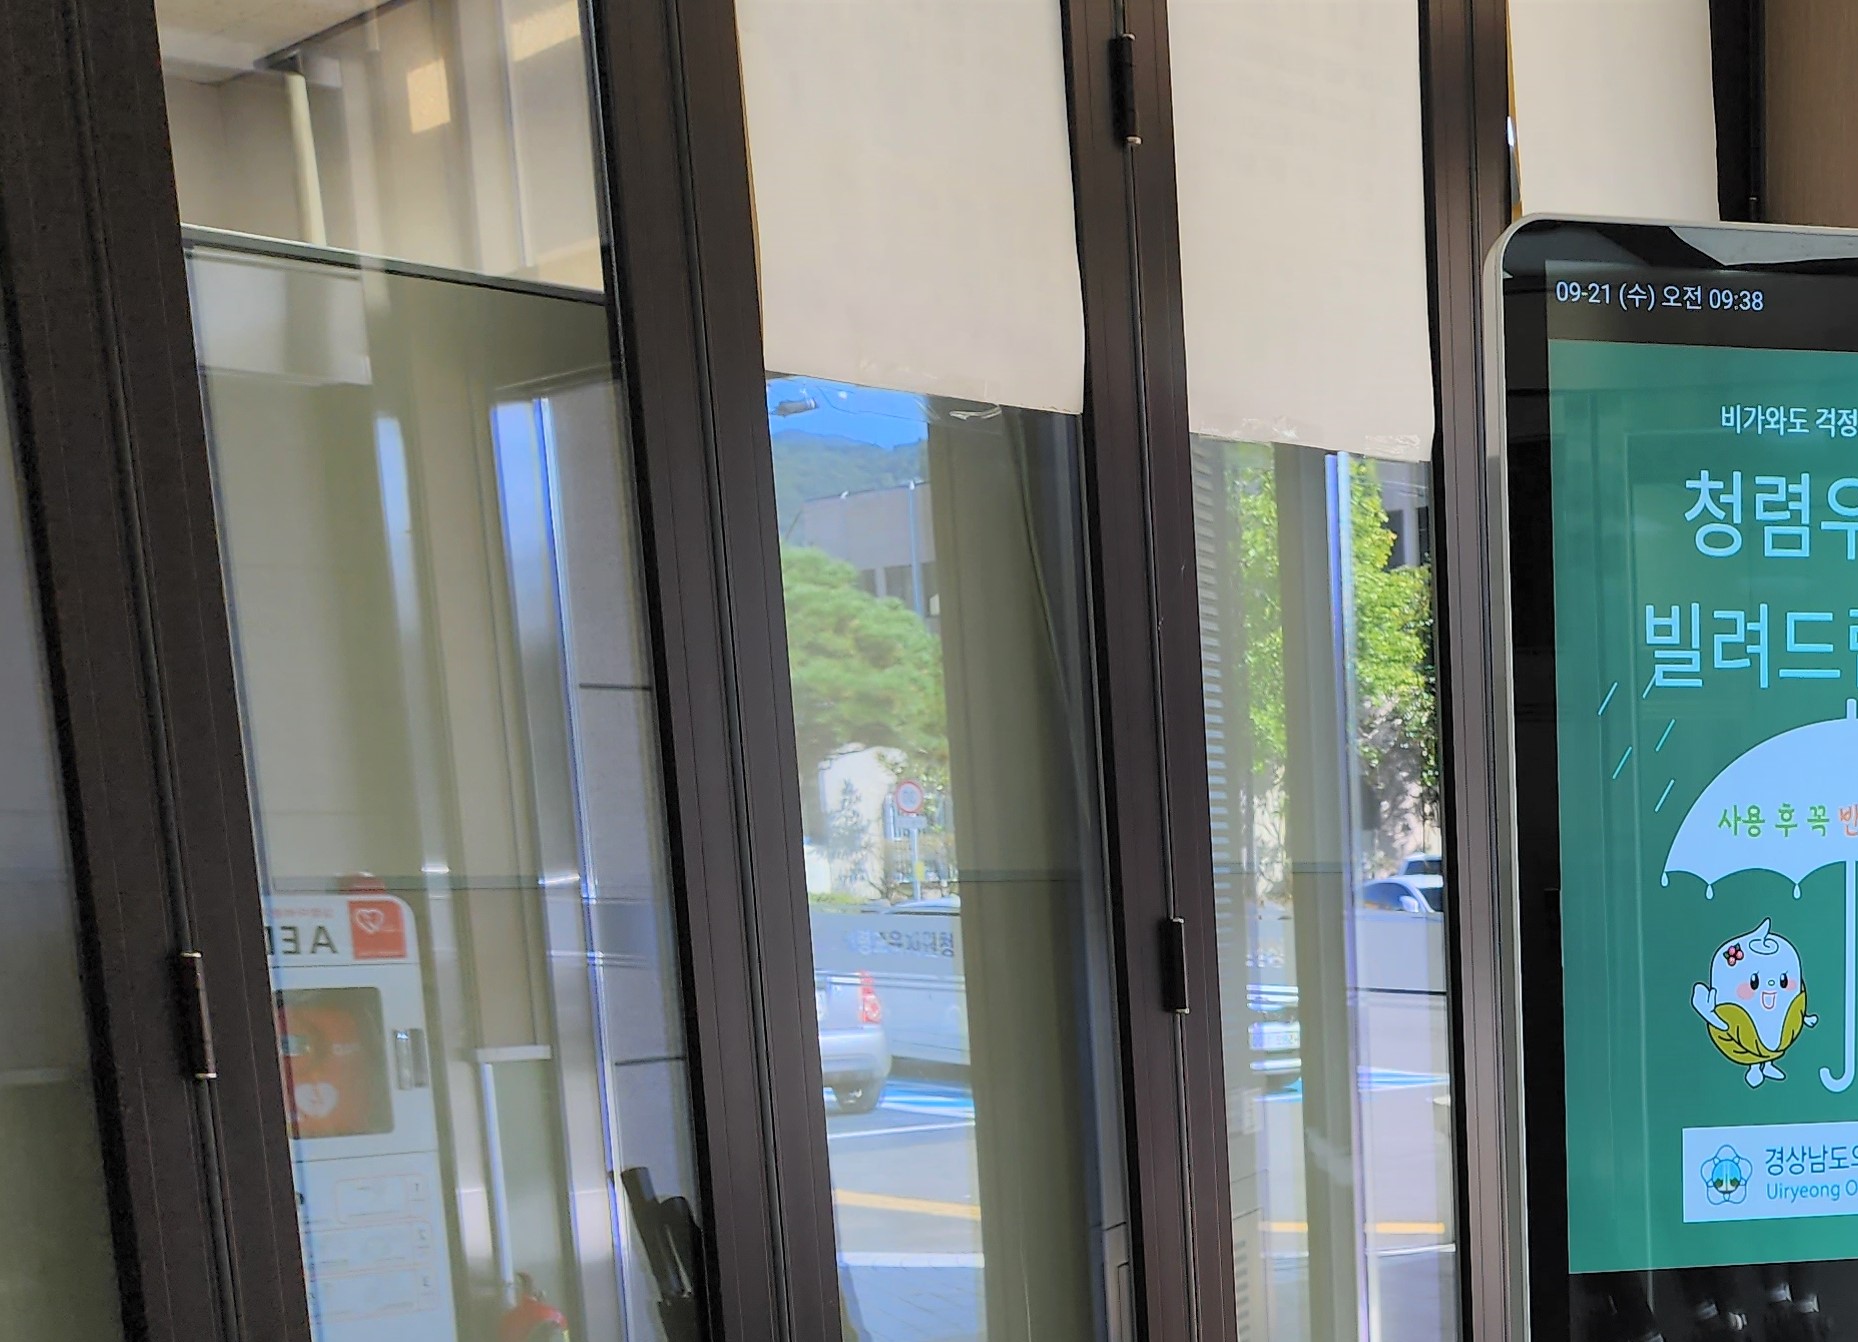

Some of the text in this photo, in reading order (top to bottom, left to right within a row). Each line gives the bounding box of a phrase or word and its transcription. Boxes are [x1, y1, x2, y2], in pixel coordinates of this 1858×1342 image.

[1556, 281, 1764, 312] 09-21 (수) 오전 09:38
[1720, 405, 1809, 436] 비가와도
[1718, 804, 1766, 838] 사용
[1775, 803, 1798, 838] 후
[1807, 805, 1831, 838] 꼭
[1766, 1181, 1842, 1204] Uiryeong
